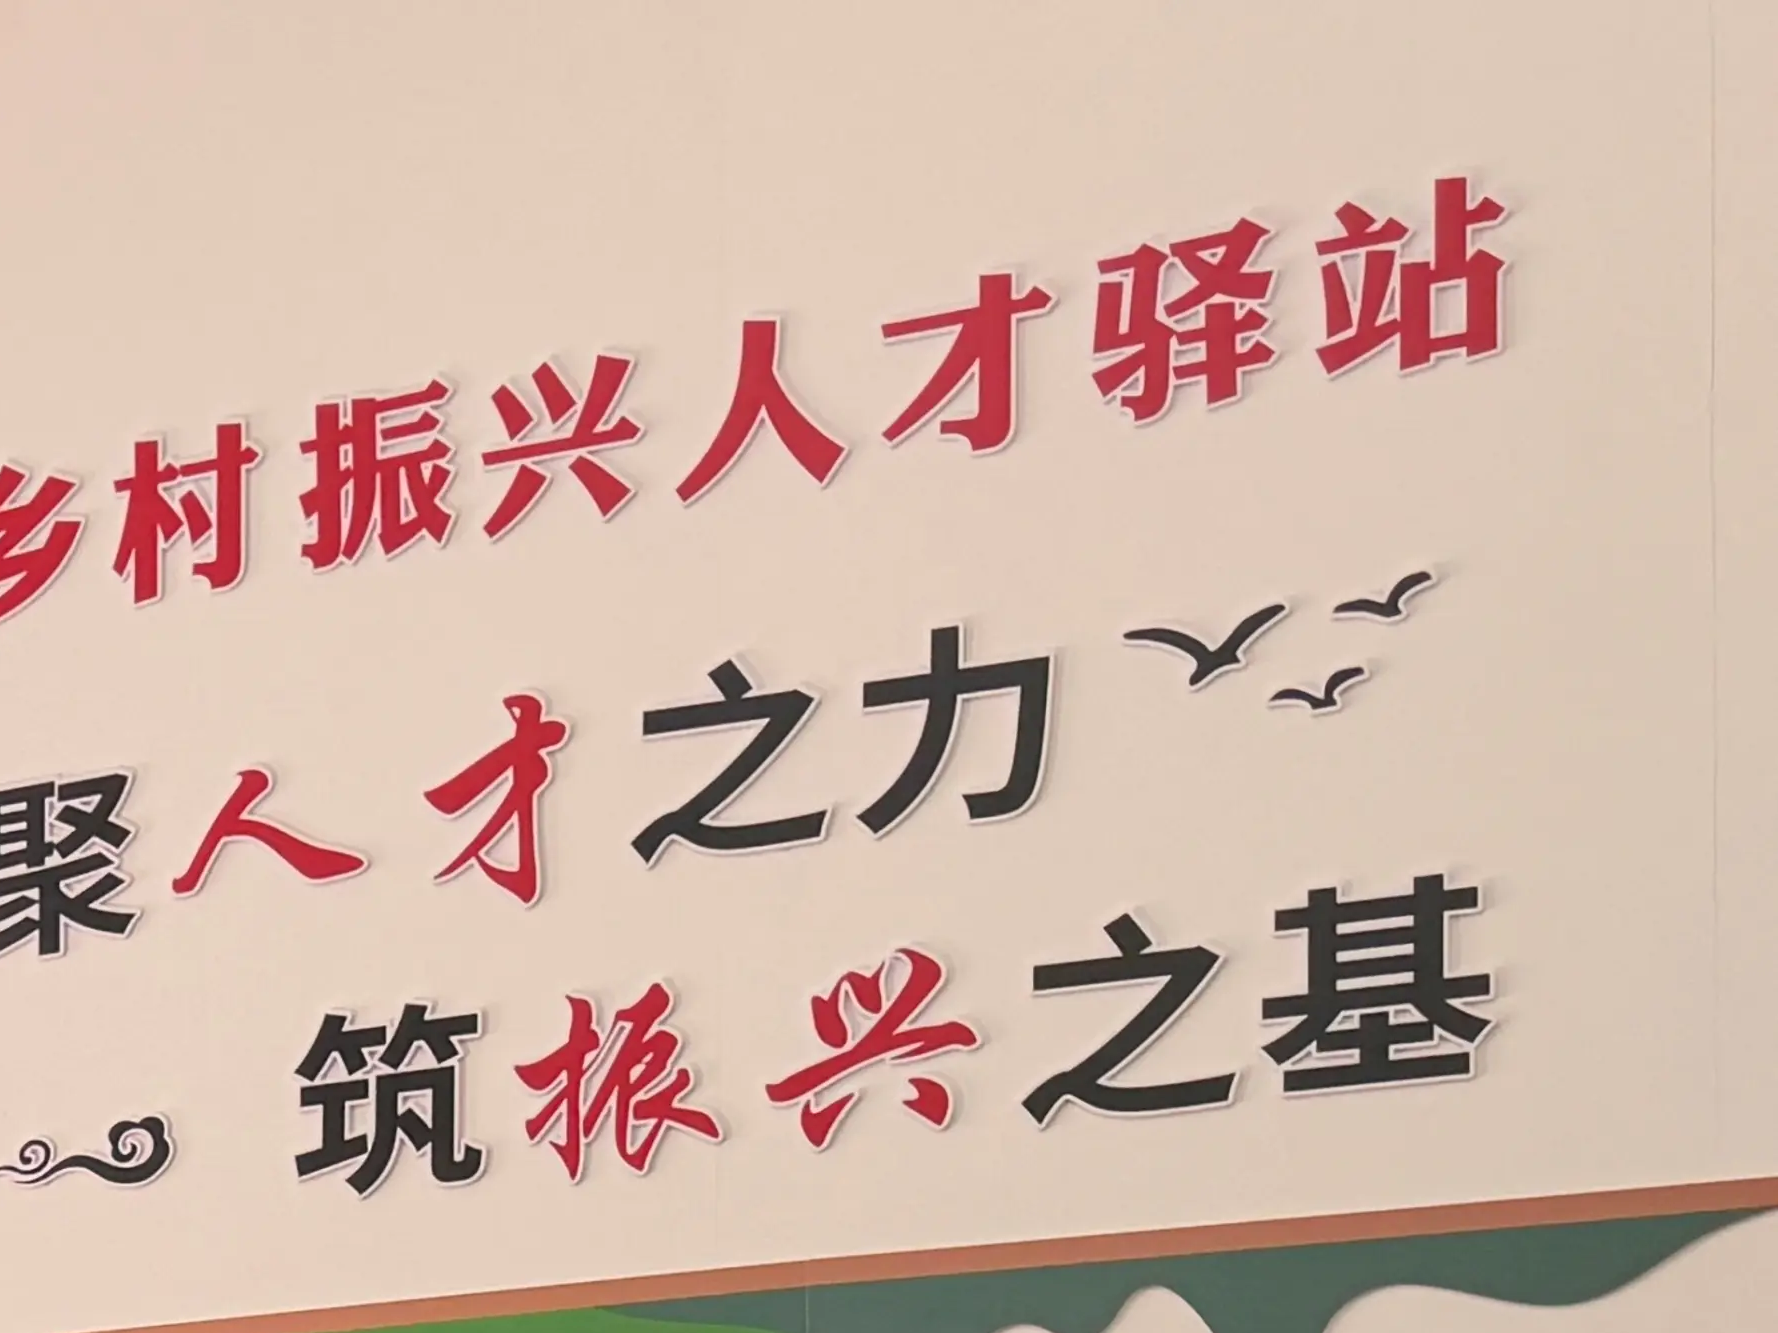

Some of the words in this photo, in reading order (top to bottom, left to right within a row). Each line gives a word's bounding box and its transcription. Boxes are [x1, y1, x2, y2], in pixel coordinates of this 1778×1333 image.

[291, 872, 1493, 1197] 筑振兴之基
